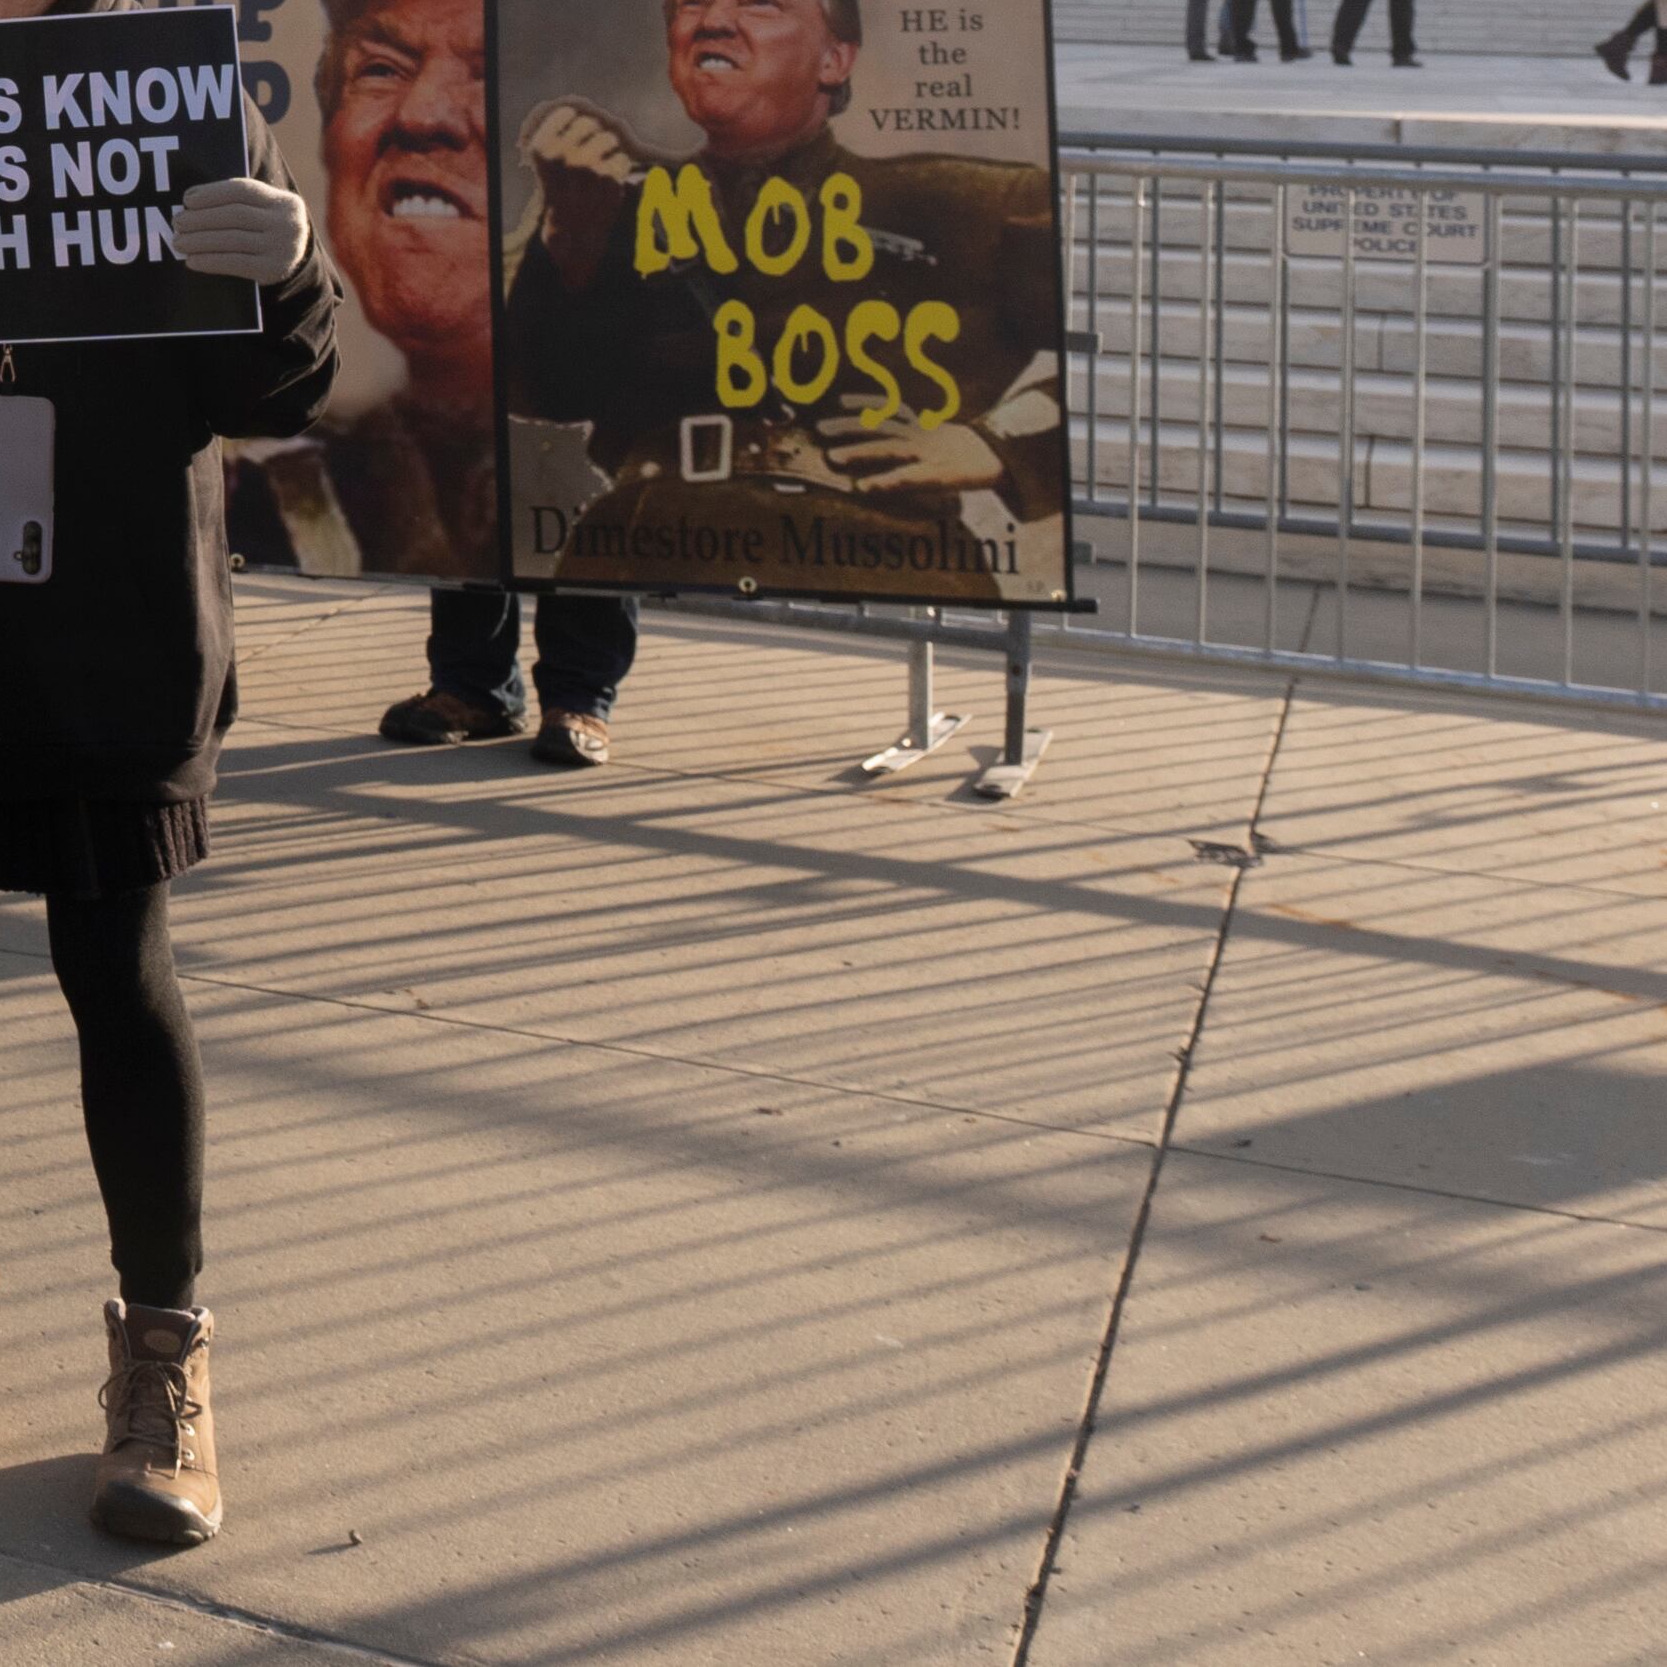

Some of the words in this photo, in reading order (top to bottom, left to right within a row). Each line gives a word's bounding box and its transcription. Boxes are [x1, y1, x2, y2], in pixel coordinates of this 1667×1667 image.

[900, 9, 949, 32] HE
[959, 8, 984, 31] is
[919, 41, 967, 65] the
[42, 64, 235, 131] KNOW
[914, 73, 973, 98] real
[868, 106, 1021, 131] VERMIN!
[51, 135, 180, 198] NOT
[52, 204, 187, 268] HUN
[633, 162, 875, 283] MOB
[713, 299, 961, 430] BOSS
[530, 505, 767, 565] Dimestore
[778, 514, 1020, 575] Mussolini
